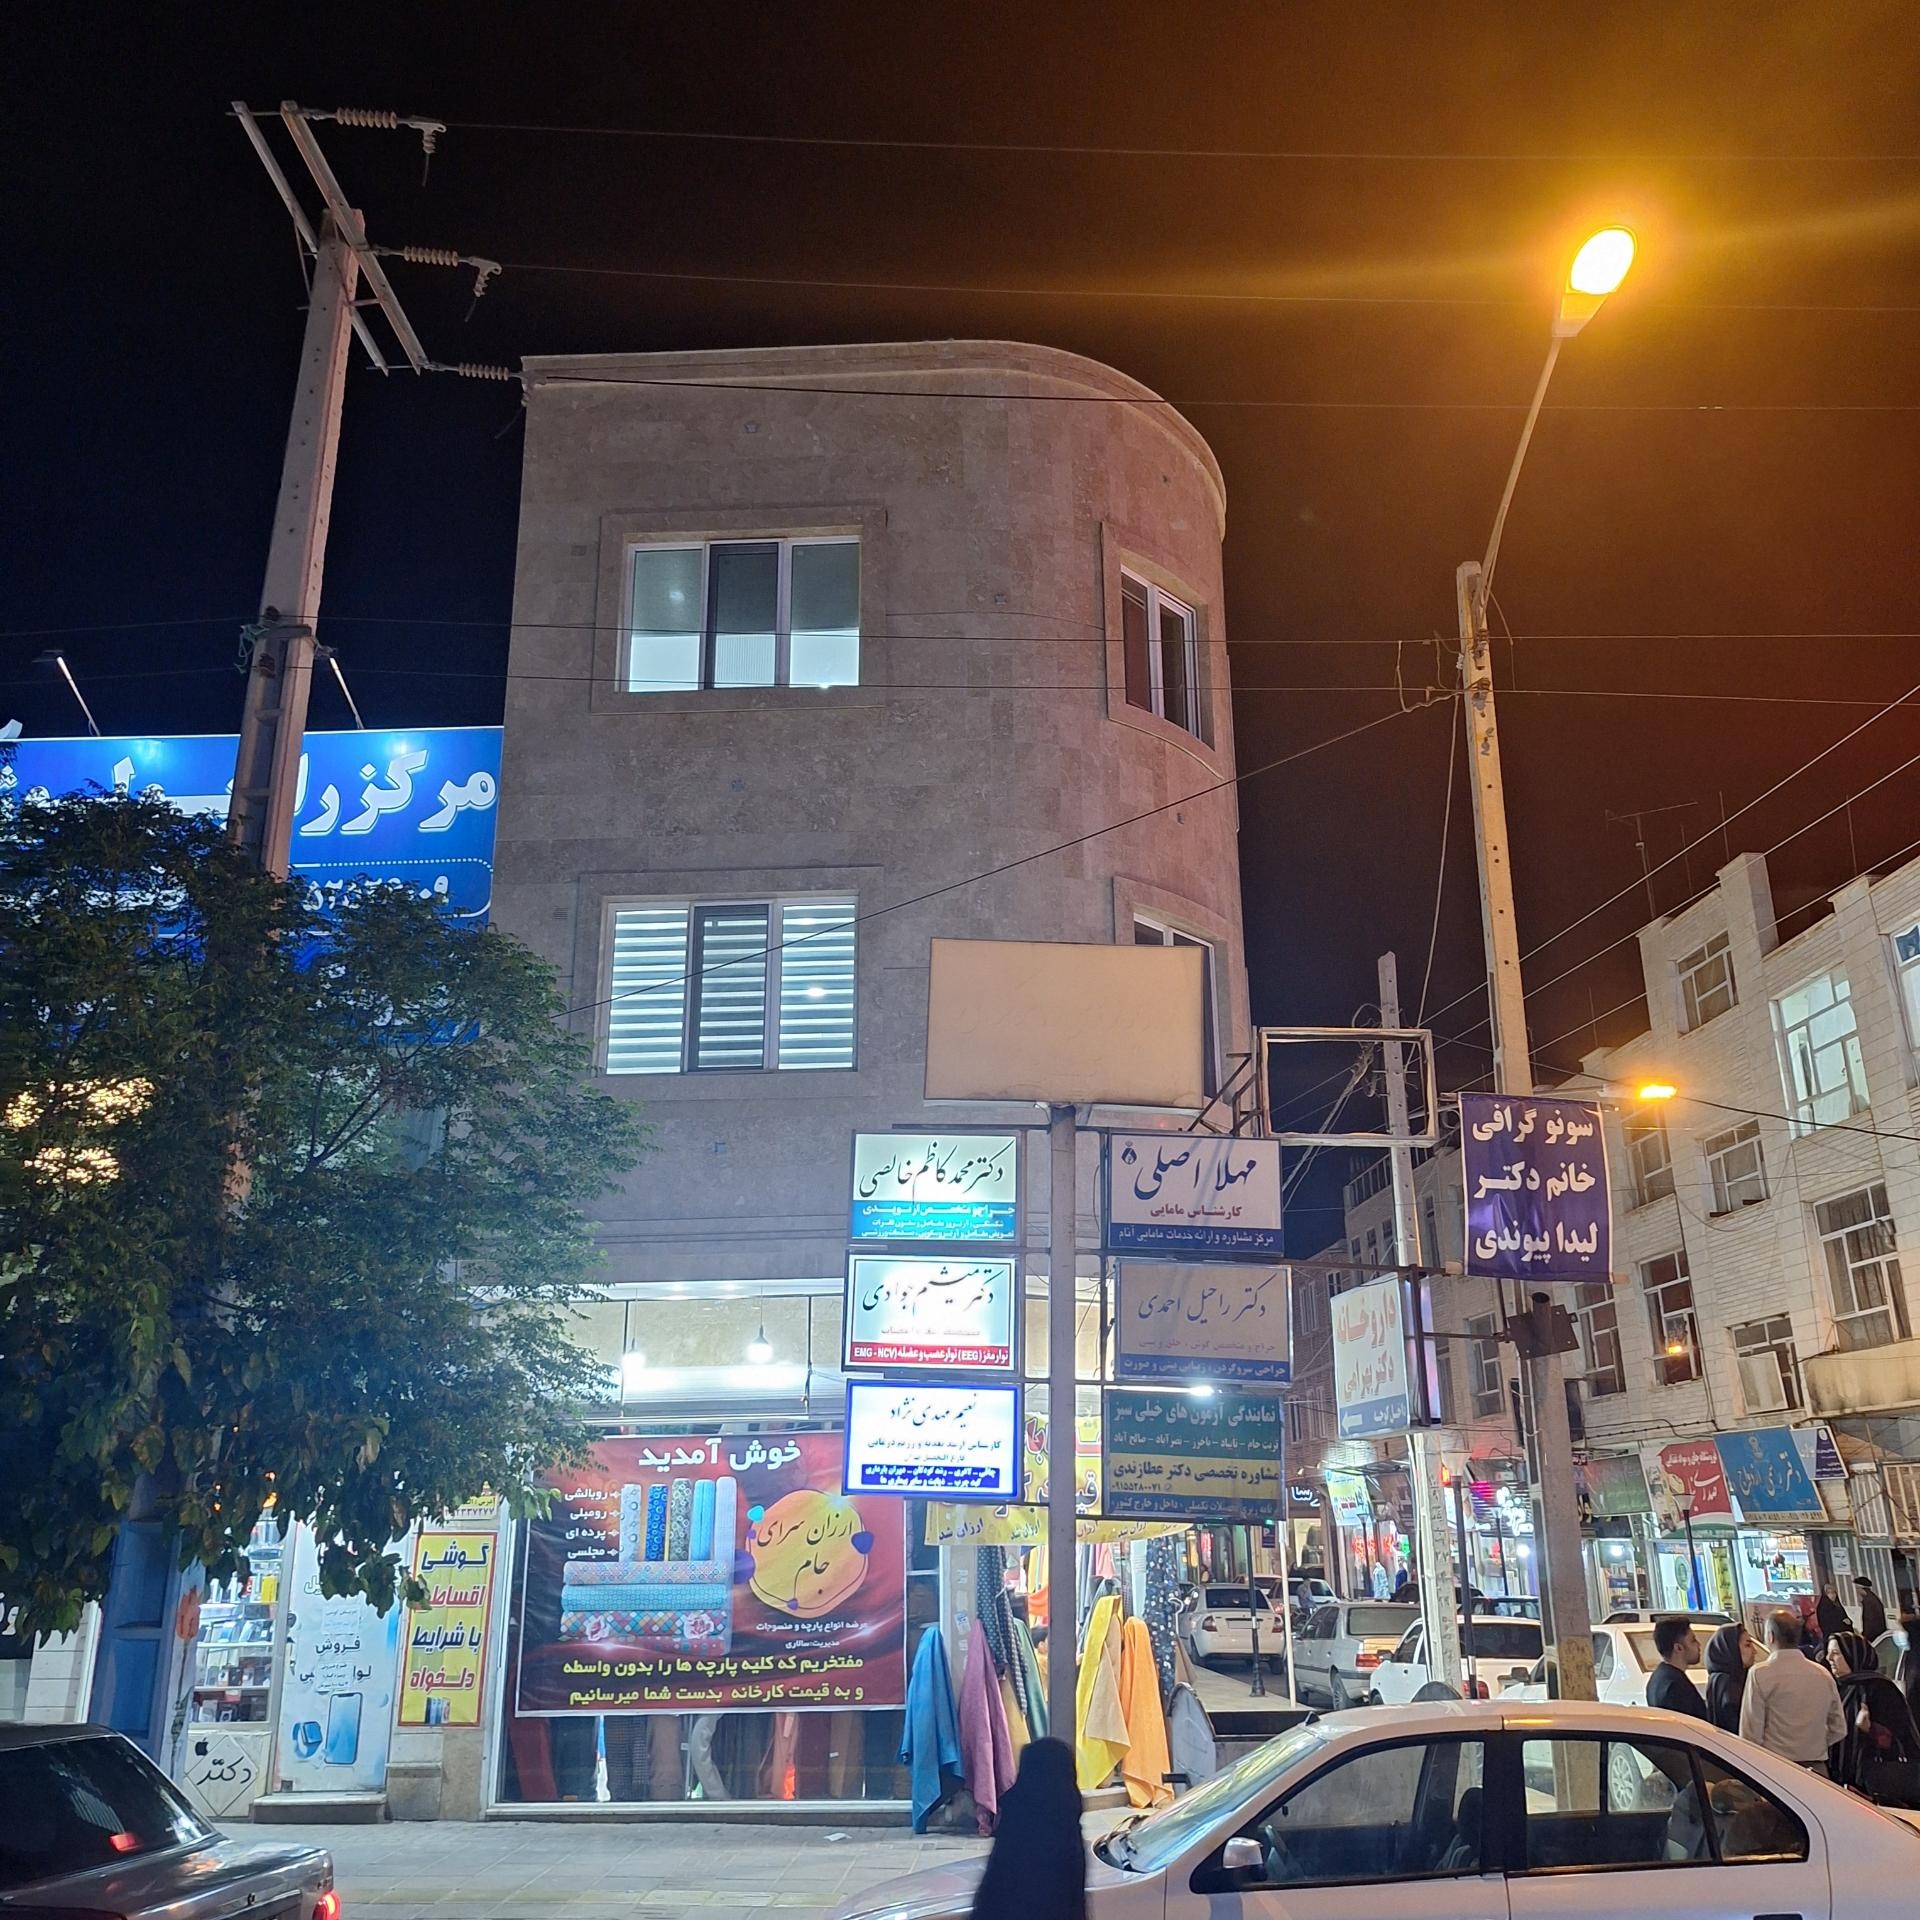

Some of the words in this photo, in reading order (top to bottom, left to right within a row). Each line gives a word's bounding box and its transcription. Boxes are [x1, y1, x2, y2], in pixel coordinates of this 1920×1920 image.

[340, 750, 497, 834] مرکز
[1545, 1109, 1593, 1145] سونو
[859, 1154, 912, 1198] خالصی
[912, 1141, 958, 1203] کاظم
[948, 1160, 974, 1185] محمد
[963, 1140, 1015, 1194] دکتر
[1134, 1145, 1201, 1200] اصلی
[1214, 1155, 1257, 1191] مهلا
[1474, 1161, 1540, 1198] دکتر
[1546, 1162, 1596, 1201] خانم
[1150, 1203, 1185, 1217] مامایی
[1188, 1205, 1242, 1220] کارشناس
[1137, 1228, 1164, 1241] مامایی
[1167, 1229, 1193, 1240] خدمات
[1222, 1231, 1252, 1245] مشاوره
[1254, 1233, 1274, 1247] مرکز
[1475, 1220, 1552, 1264] پیوندی
[1556, 1221, 1599, 1262] لیدا
[964, 1268, 1005, 1312] دکتر
[1232, 1272, 1278, 1322] دکتر
[1138, 1294, 1181, 1319] احمدی
[1186, 1286, 1231, 1324] راحیل
[1114, 1401, 1132, 1422] سبز
[1135, 1400, 1163, 1421] خیلی
[1166, 1402, 1187, 1424] های
[1191, 1402, 1224, 1425] آزمون
[1228, 1404, 1275, 1427] نمایندگی
[638, 1437, 722, 1472] آمدید
[729, 1438, 801, 1471] خوش
[1167, 1463, 1191, 1480] دکتر
[1194, 1466, 1238, 1482] تخصصی
[564, 1488, 609, 1501] روبالشی
[569, 1506, 608, 1520] رومبلی
[565, 1527, 580, 1540] ای
[581, 1528, 607, 1541] پرده
[757, 1520, 805, 1547] سرای
[806, 1513, 853, 1545] ارزان
[938, 1527, 953, 1541] شد
[957, 1518, 984, 1538] ارزان
[421, 1541, 490, 1570] گوشی
[567, 1546, 606, 1559] مجلسی
[794, 1552, 830, 1597] جام
[756, 1622, 793, 1631] منسوجات
[801, 1621, 823, 1632] پارچه
[825, 1621, 844, 1632] انواع
[316, 1636, 361, 1655] فروش
[412, 1621, 465, 1653] شرایط
[468, 1626, 482, 1653] با
[563, 1659, 611, 1677] واسطه
[614, 1660, 653, 1676] بدون
[658, 1658, 672, 1676] را
[676, 1657, 692, 1673] ها
[696, 1658, 738, 1677] پارچه
[742, 1656, 775, 1674] کلیه
[778, 1655, 797, 1670] که
[800, 1657, 864, 1673] مفتخریم
[410, 1667, 475, 1692] دلخواه
[644, 1686, 670, 1703] شما
[676, 1685, 724, 1703] بدست
[730, 1684, 786, 1702] کارخانه
[788, 1684, 831, 1702] قیمت
[833, 1685, 853, 1699] به
[855, 1685, 864, 1701] و
[196, 1756, 252, 1786] دکتر
